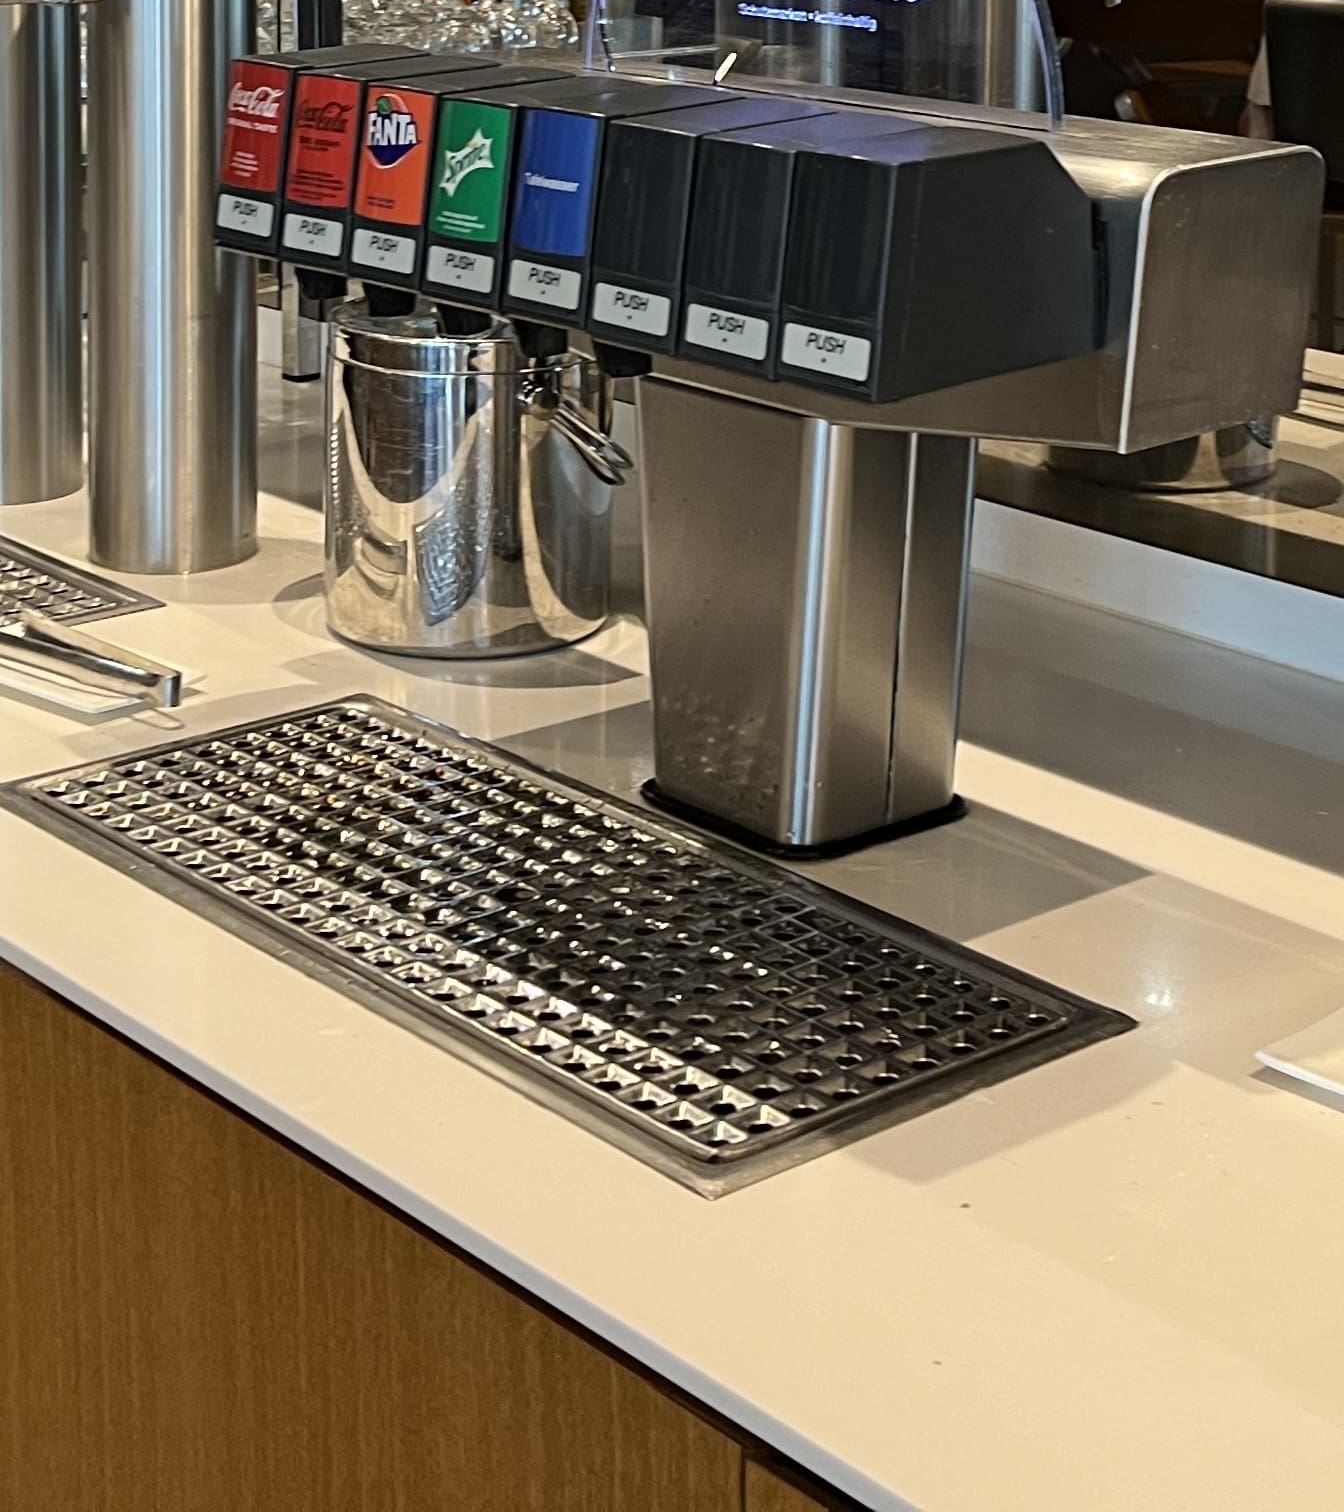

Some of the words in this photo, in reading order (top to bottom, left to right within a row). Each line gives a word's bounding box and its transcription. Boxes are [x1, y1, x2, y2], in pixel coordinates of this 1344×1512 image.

[227, 82, 284, 118] Coca-Cola
[367, 112, 417, 146] FANTA
[232, 201, 258, 217] PUSH
[300, 220, 327, 236] PUSH
[370, 236, 399, 252] PUSH
[445, 254, 475, 270] PUSH
[529, 268, 561, 287] PUSH
[614, 292, 648, 312] PUSH
[707, 314, 744, 335] PUSH
[806, 333, 845, 355] PUSH
